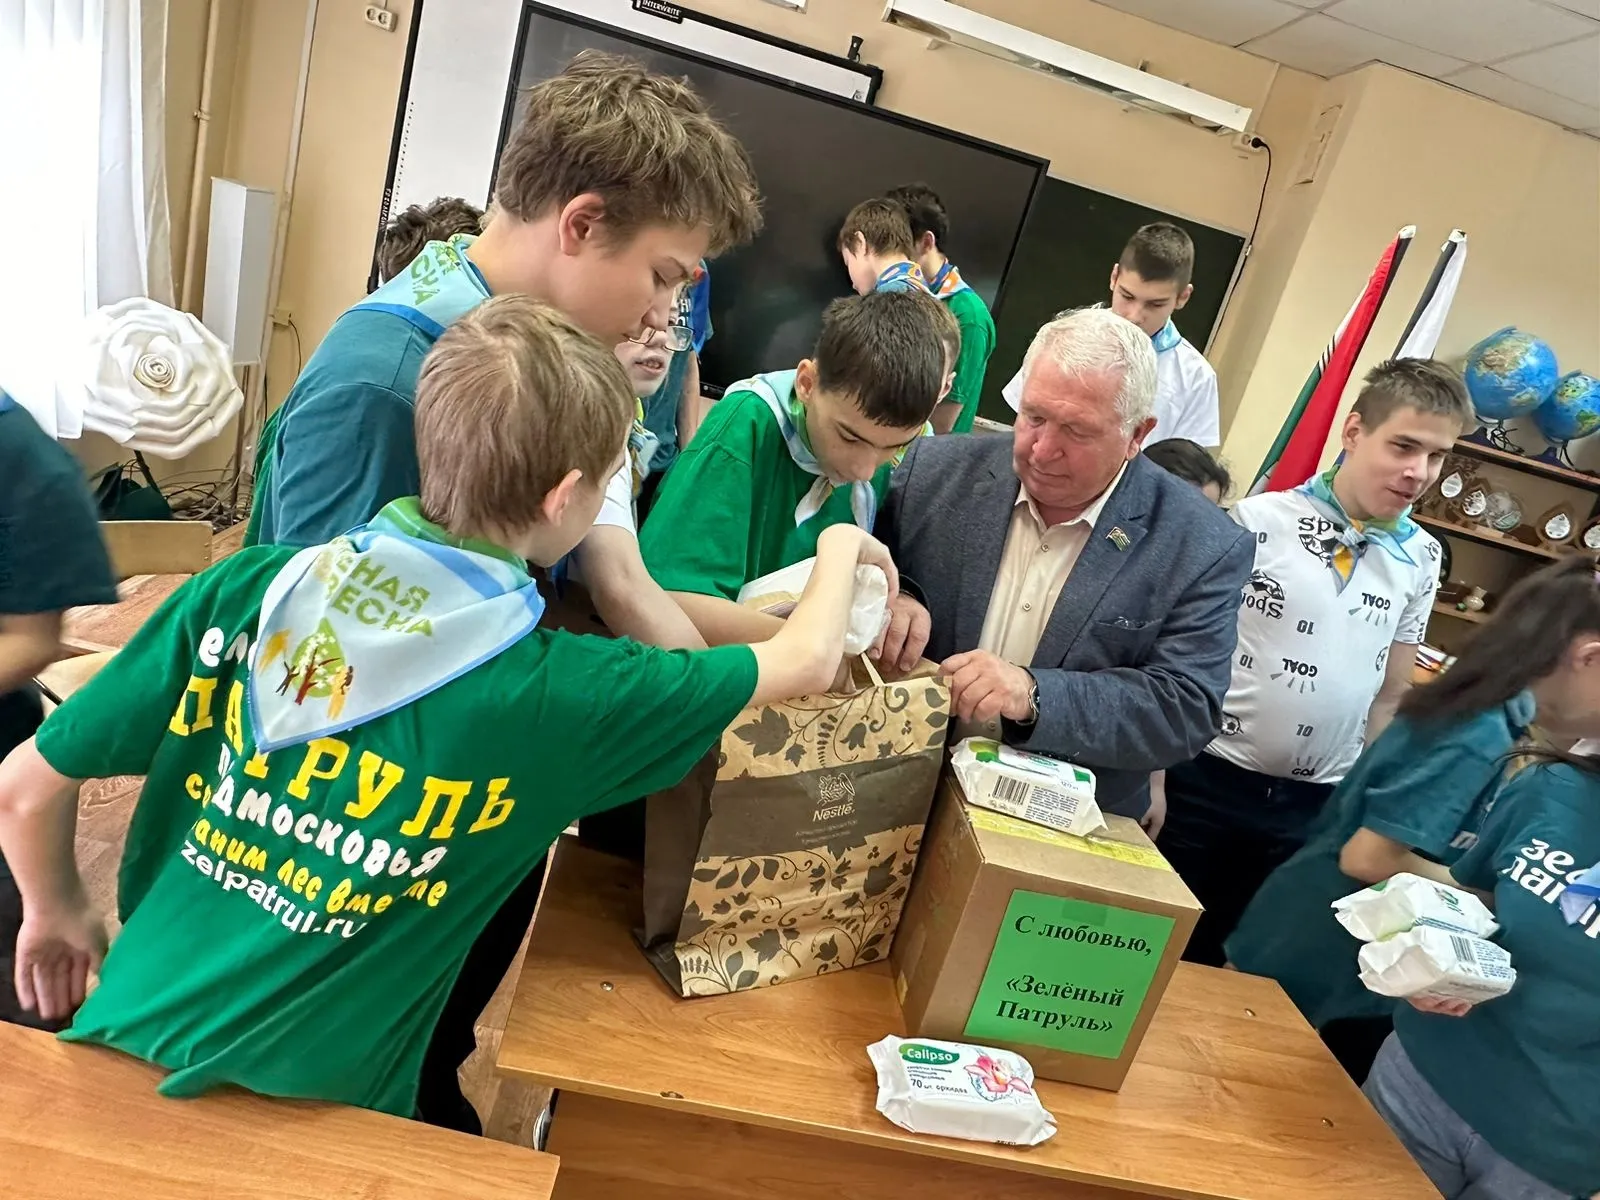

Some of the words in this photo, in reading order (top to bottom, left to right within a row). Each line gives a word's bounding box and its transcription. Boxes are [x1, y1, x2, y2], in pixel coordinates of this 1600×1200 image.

[1362, 592, 1391, 611] GOAL
[1297, 619, 1314, 635] 10
[1239, 654, 1253, 669] 10
[1282, 658, 1318, 678] GOAL
[1296, 724, 1314, 737] 10
[181, 839, 366, 939] zelpatrul.ru
[277, 858, 322, 902] лес
[1014, 915, 1036, 934] С
[1038, 924, 1152, 956] любовью,
[1006, 974, 1125, 1007] «Зелёный
[996, 1000, 1113, 1032] Патруль»
[906, 1047, 953, 1062] Calipso
[910, 1078, 923, 1089] 70
